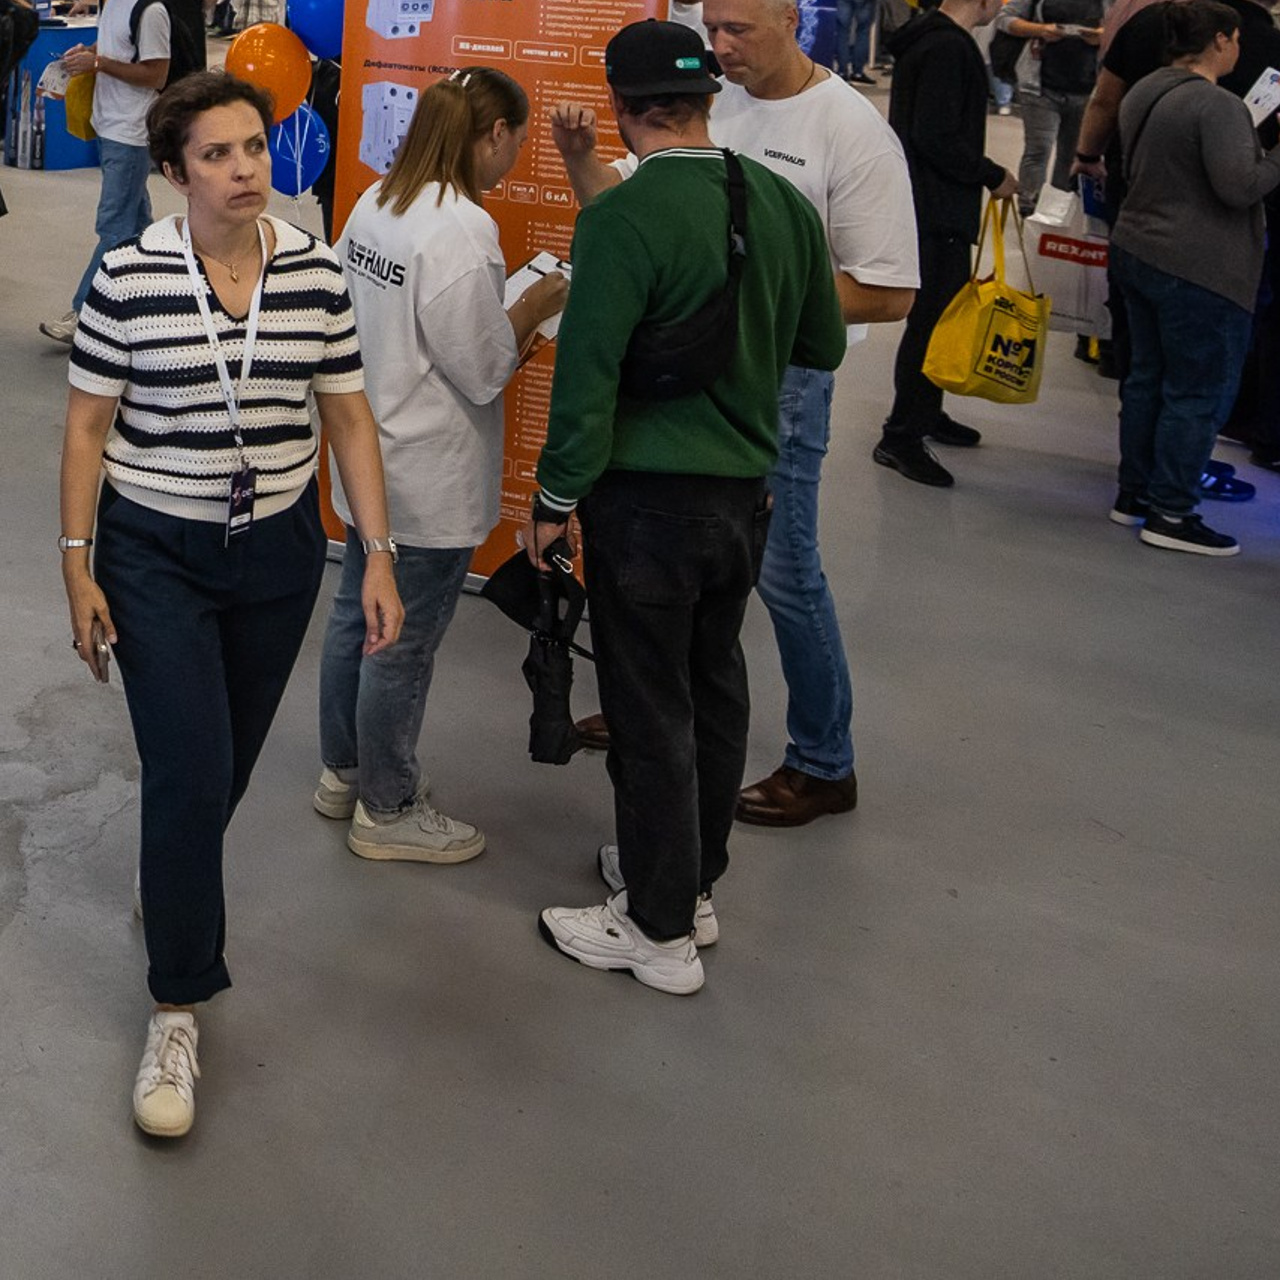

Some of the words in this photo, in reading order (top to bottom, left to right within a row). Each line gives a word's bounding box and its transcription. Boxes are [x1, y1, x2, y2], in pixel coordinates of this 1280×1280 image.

[363, 58, 426, 72] Дифавтоматы
[553, 193, 569, 202] кА
[1045, 240, 1107, 261] REXANT
